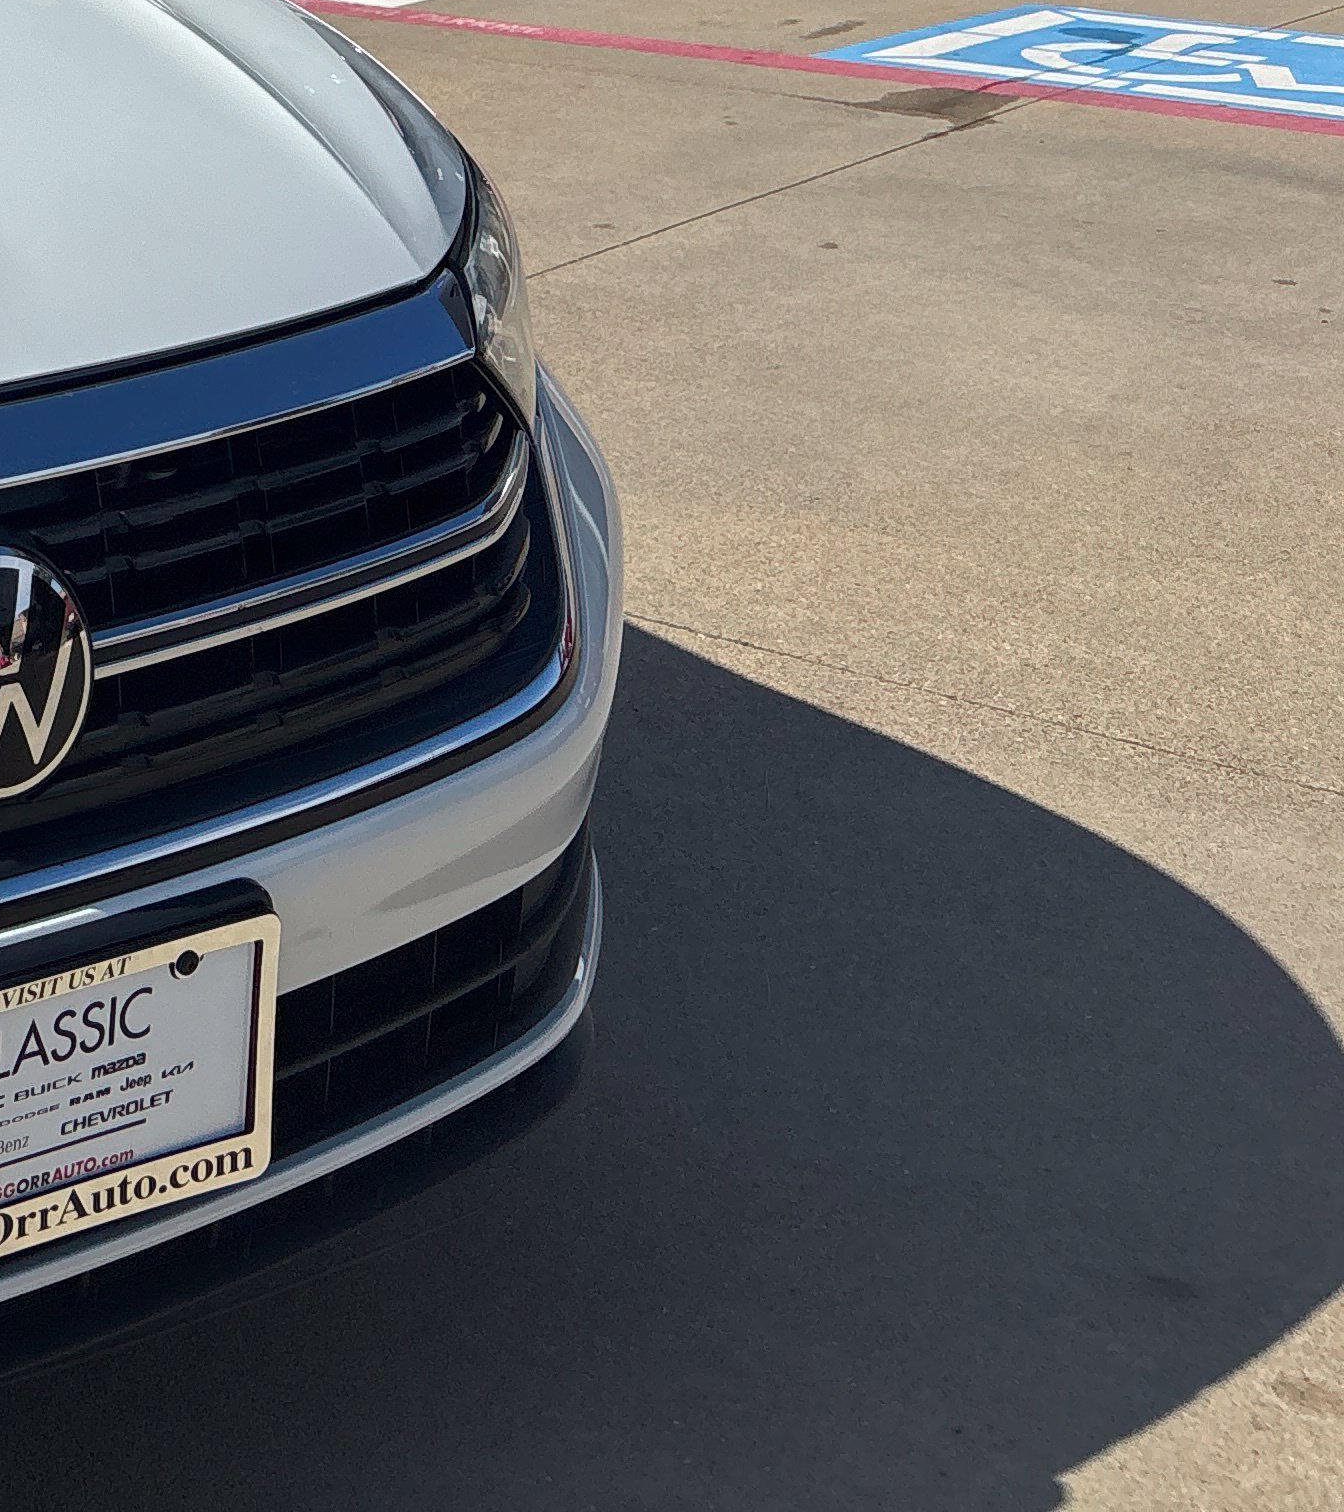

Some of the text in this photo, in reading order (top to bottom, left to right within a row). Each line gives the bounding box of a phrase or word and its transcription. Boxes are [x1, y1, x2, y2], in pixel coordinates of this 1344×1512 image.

[2, 957, 132, 1009] VISIT US AT
[14, 1072, 83, 1102] BUICK
[91, 1052, 146, 1080] mazda
[69, 1087, 111, 1107] RAM
[120, 1073, 152, 1093] Jeep
[161, 1060, 195, 1079] KIA
[61, 1089, 174, 1136] CHEVROLET
